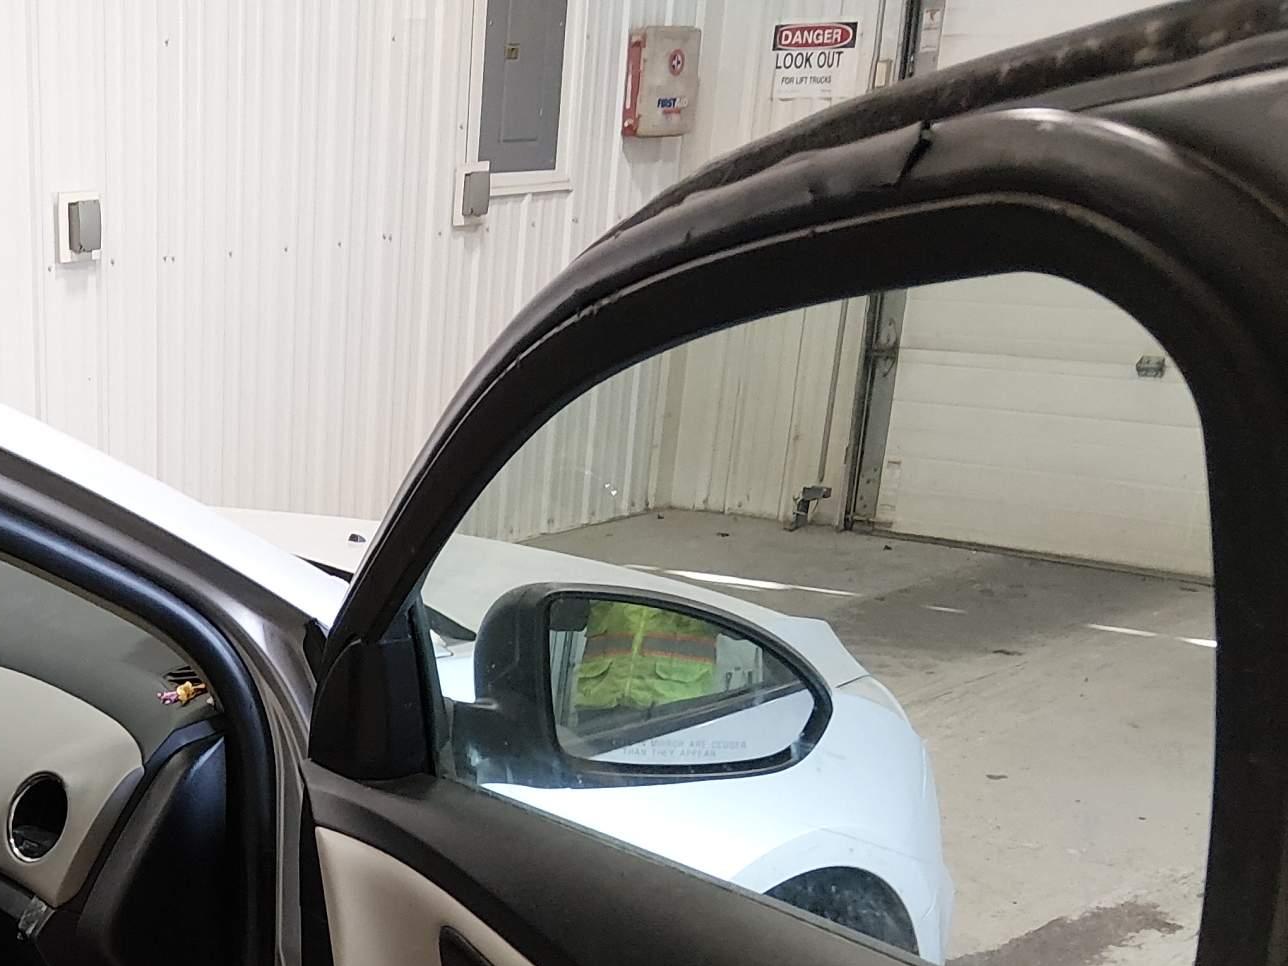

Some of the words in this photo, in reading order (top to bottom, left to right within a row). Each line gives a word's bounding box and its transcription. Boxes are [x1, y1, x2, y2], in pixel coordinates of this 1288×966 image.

[781, 28, 842, 45] DANGER
[775, 51, 814, 69] LOOK
[817, 50, 844, 68] OUT
[781, 76, 794, 85] FOR
[795, 76, 808, 85] LIFT
[809, 75, 832, 85] TRUCKS
